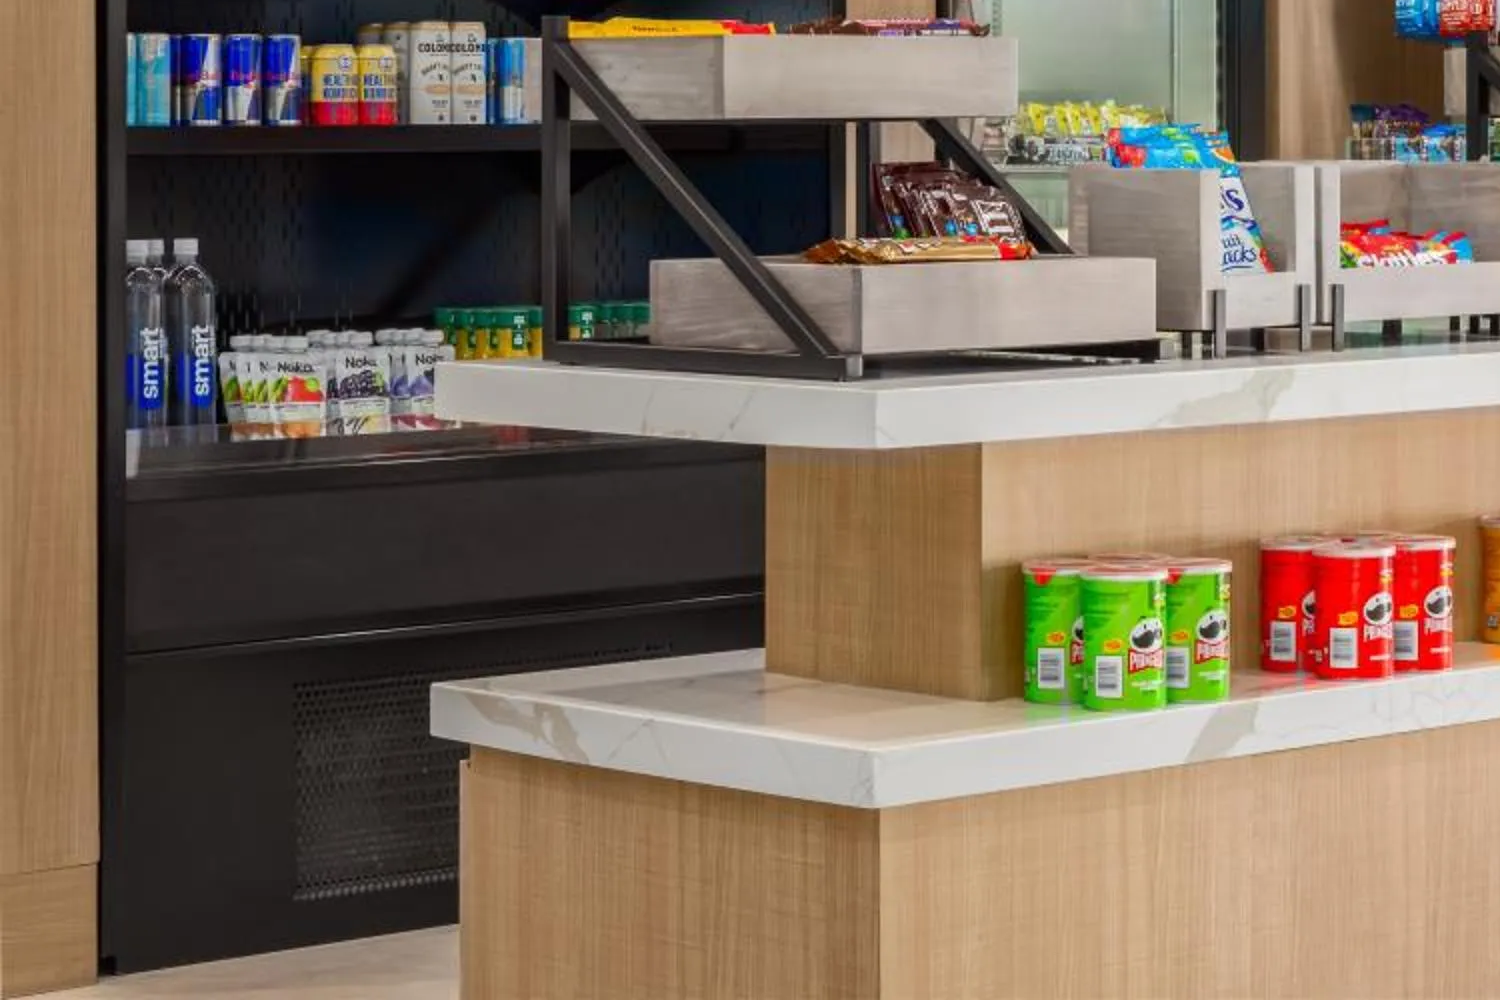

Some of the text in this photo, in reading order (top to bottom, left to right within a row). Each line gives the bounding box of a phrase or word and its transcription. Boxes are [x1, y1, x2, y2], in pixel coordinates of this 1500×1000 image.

[1222, 250, 1257, 266] acks
[141, 327, 159, 399] smart
[192, 324, 210, 397] smart
